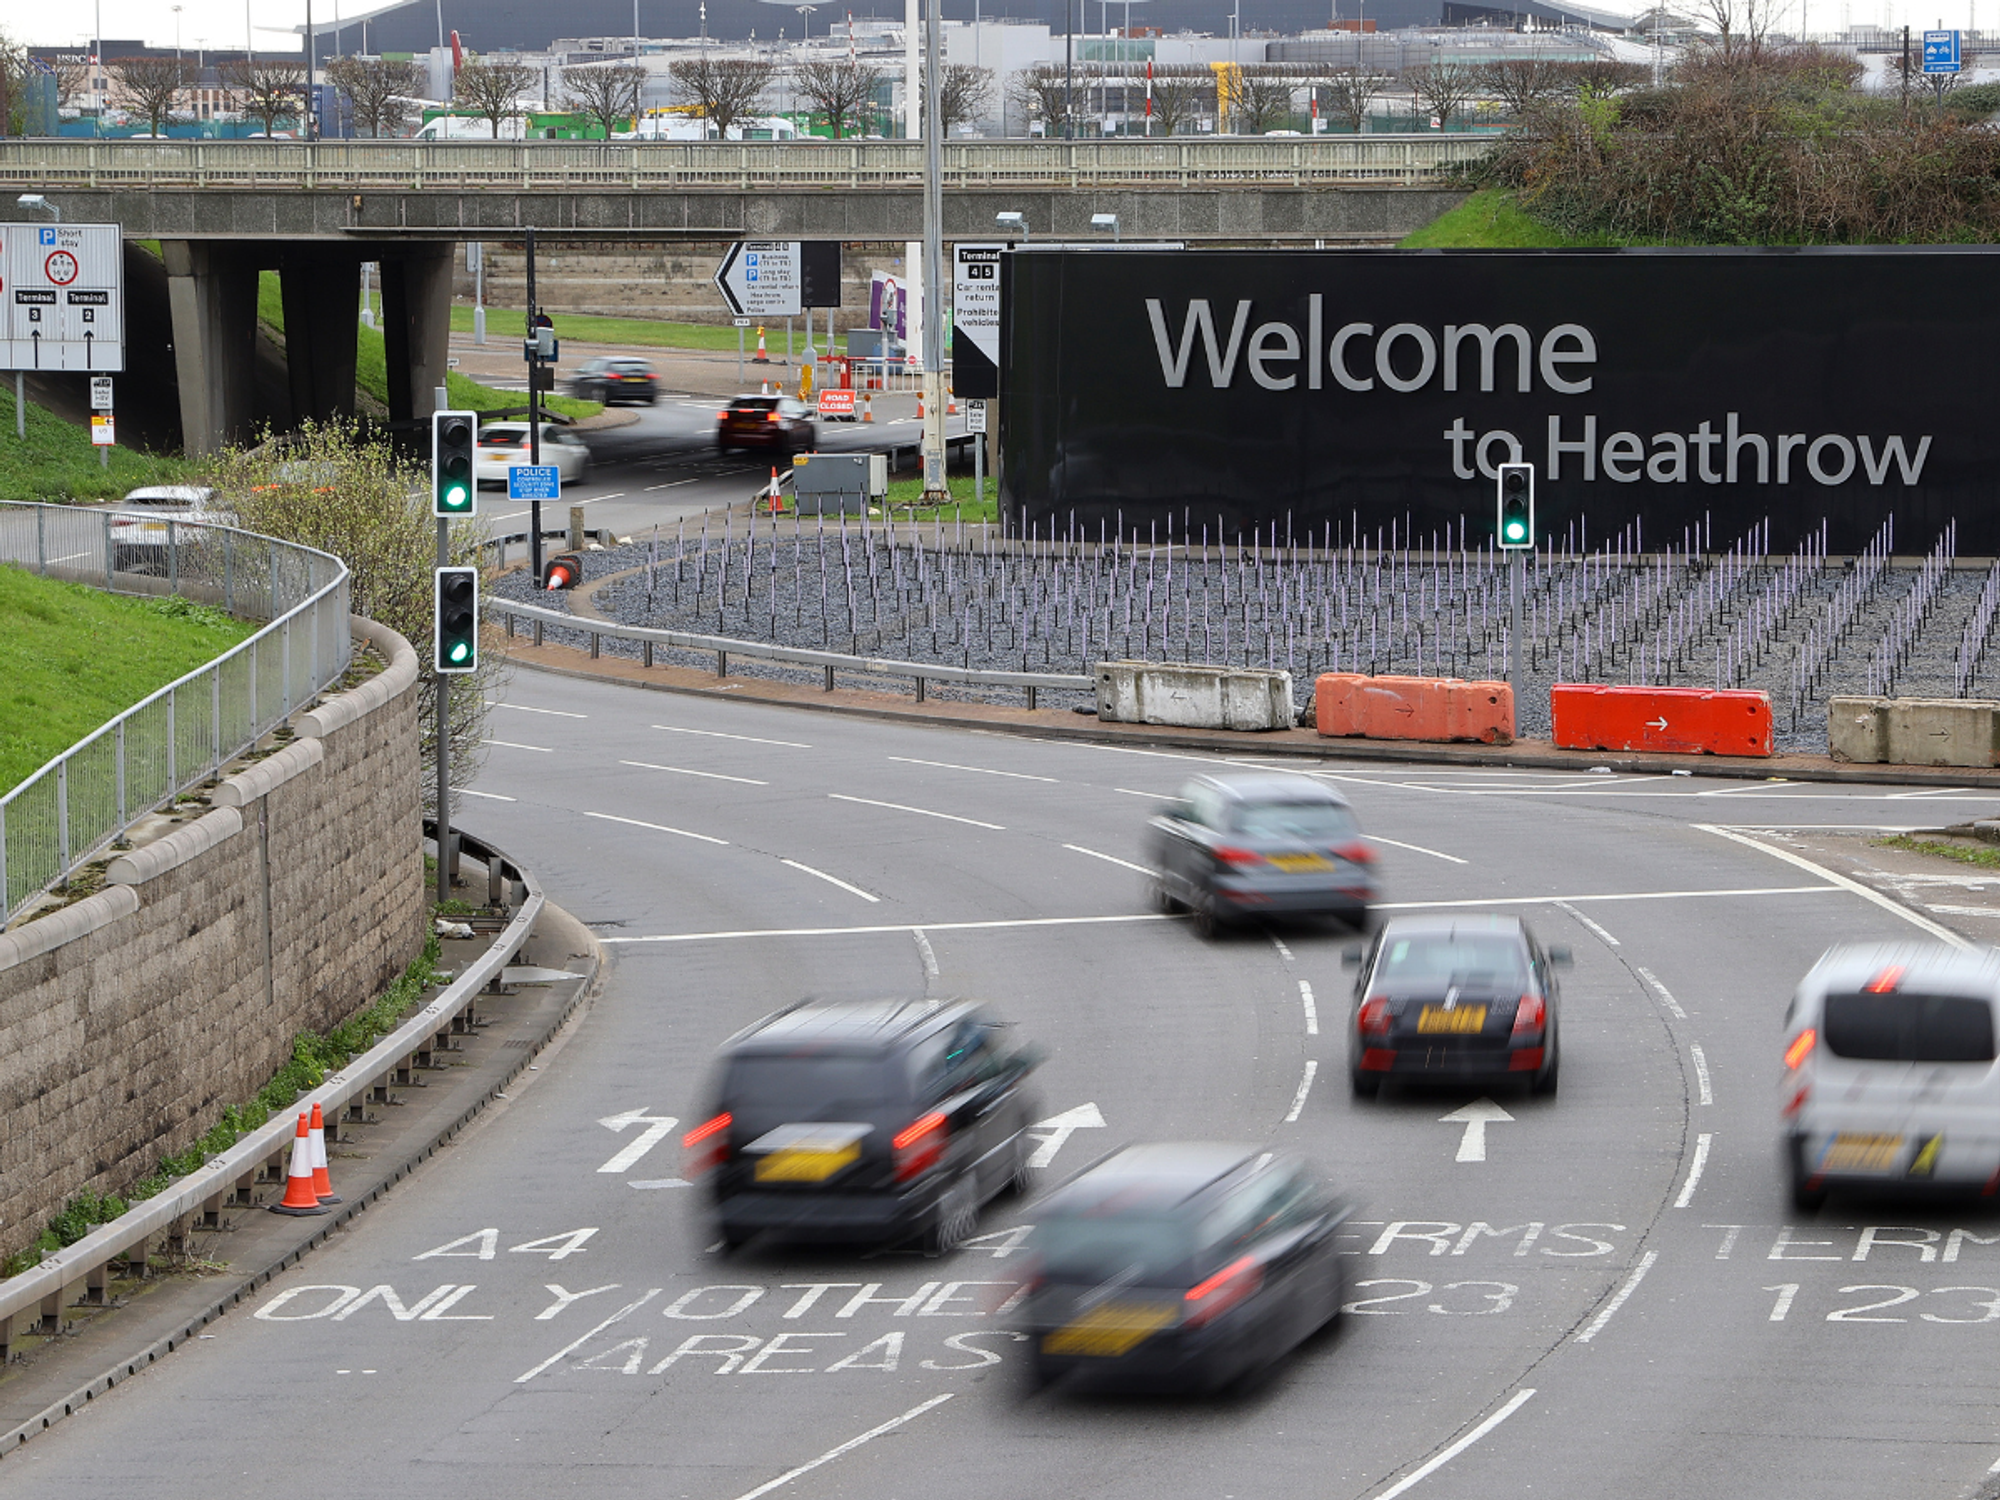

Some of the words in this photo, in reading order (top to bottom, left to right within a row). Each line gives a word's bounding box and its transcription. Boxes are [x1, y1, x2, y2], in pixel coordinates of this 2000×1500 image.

[43, 230, 54, 244] P
[57, 229, 82, 237] Short
[61, 239, 79, 247] stay
[962, 251, 999, 260] Terminal
[971, 267, 978, 276] 4
[984, 266, 991, 277] 5
[957, 283, 973, 291] Car
[976, 283, 999, 291] renta
[18, 293, 55, 302] Terminal
[69, 293, 107, 303] Terminal
[31, 310, 39, 319] 3
[84, 310, 93, 320] 2
[957, 308, 999, 316] Prohibite
[1145, 292, 1597, 394] Welcome
[820, 402, 853, 410] CLOSED
[1443, 417, 1522, 480] to
[1547, 412, 1932, 486] Heathrow
[517, 468, 552, 476] POLICE
[411, 1228, 600, 1260] A4
[1340, 1278, 1520, 1316] 23
[575, 1331, 1030, 1375] AREAS
